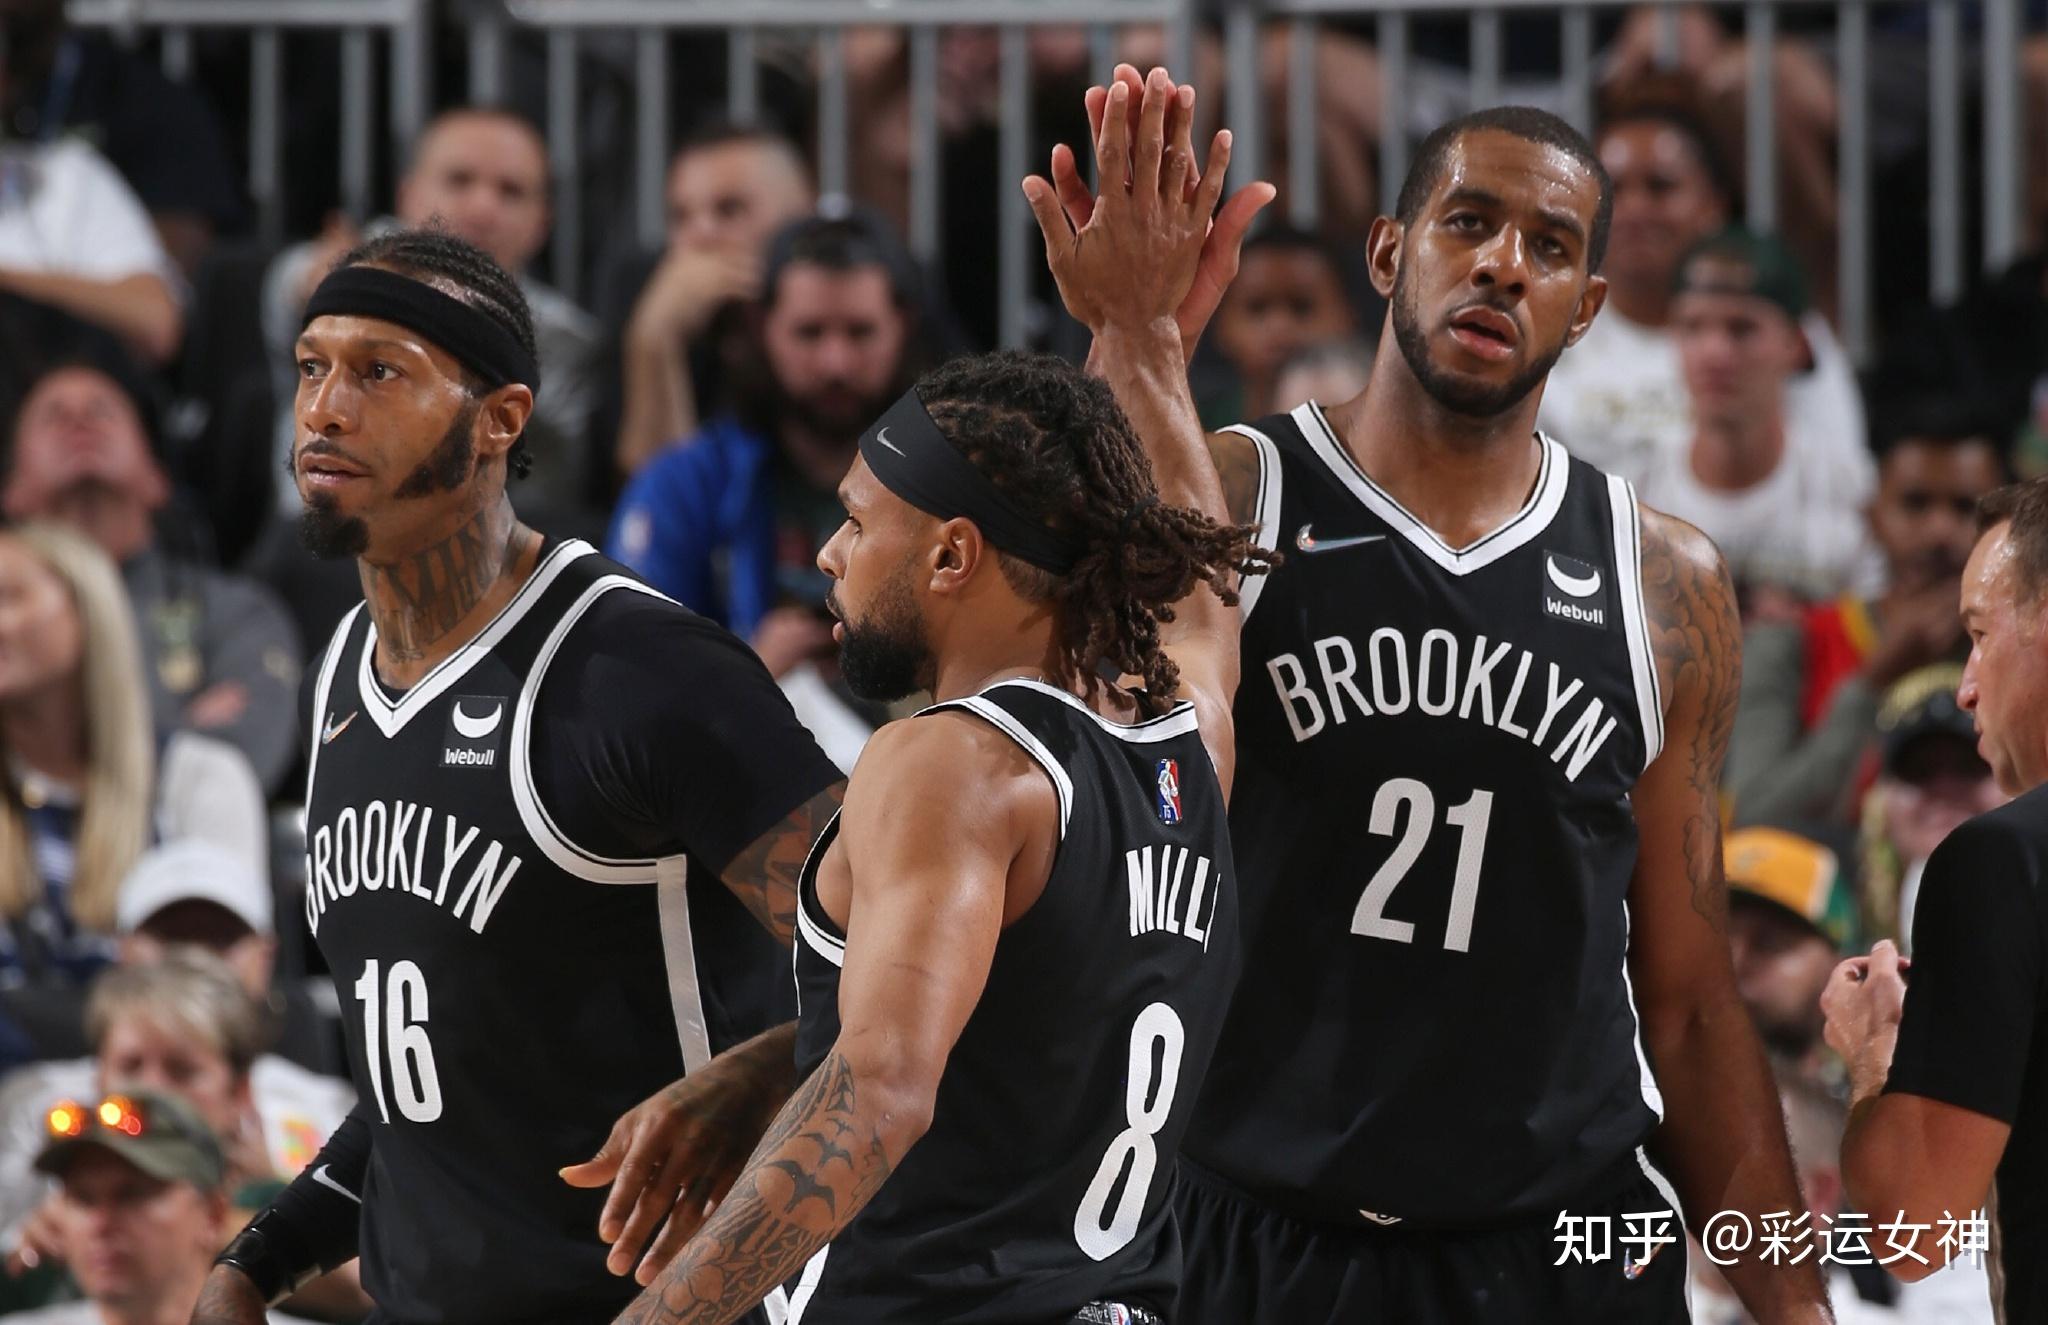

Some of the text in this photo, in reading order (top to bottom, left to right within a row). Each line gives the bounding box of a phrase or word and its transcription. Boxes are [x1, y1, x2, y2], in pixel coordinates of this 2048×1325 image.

[1546, 596, 1604, 625] Webull
[444, 748, 495, 766] Webull
[1266, 627, 1617, 783] BROOKLYN
[1126, 844, 1221, 954] MILL
[1350, 777, 1494, 953] 21
[355, 958, 443, 1125] 16
[1074, 1001, 1185, 1262] 8
